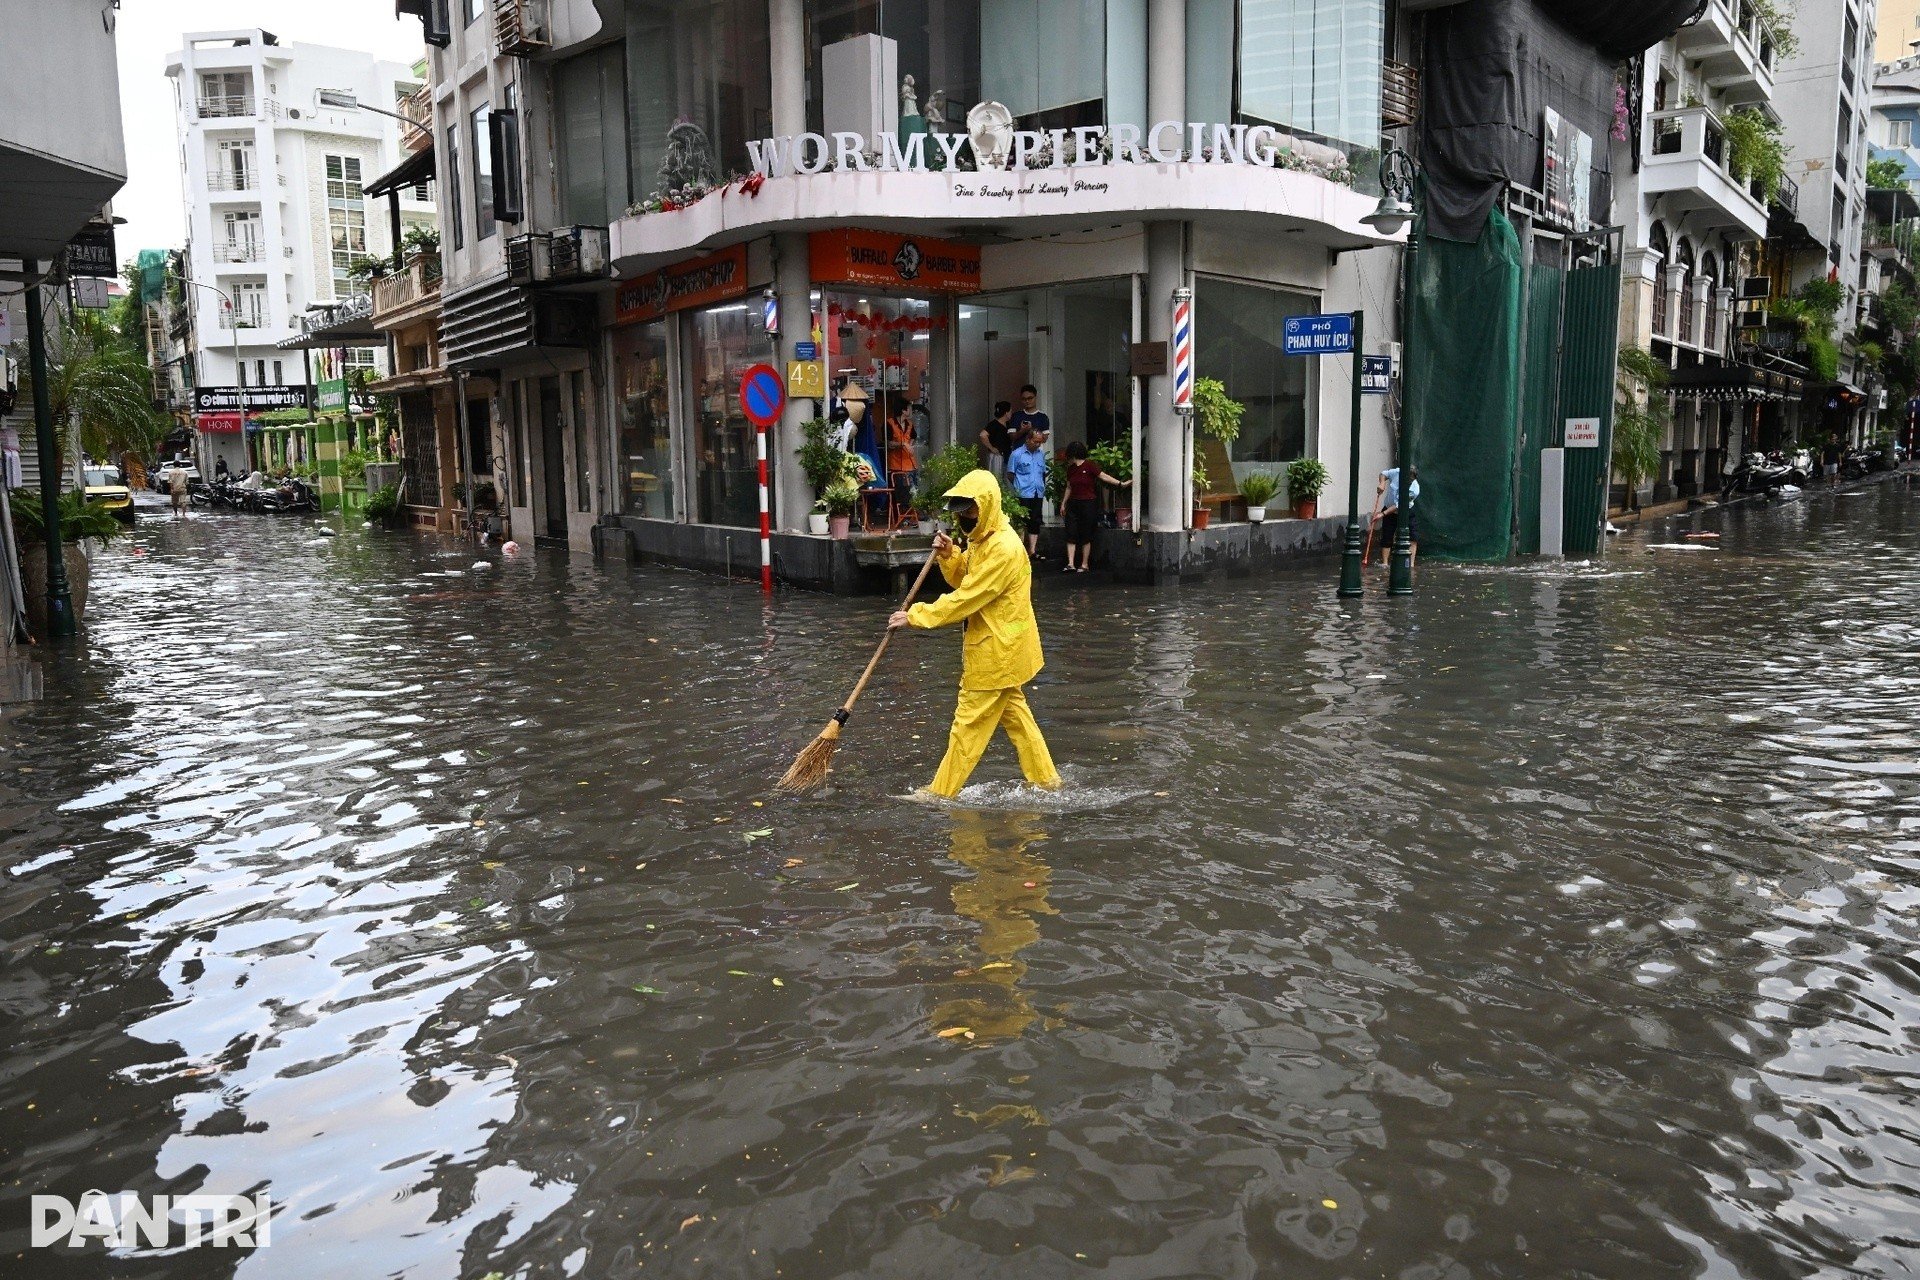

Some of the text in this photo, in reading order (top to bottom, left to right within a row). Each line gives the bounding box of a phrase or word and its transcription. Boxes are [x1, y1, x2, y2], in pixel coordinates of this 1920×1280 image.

[746, 119, 1277, 178] WORMY PIERCING
[954, 184, 975, 197] Fine
[1017, 183, 1034, 195] and
[1038, 182, 1069, 197] Luxury
[1073, 179, 1109, 194] Piercing
[850, 247, 980, 275] BUFFALO BARBER SHOP
[1311, 320, 1331, 331] PHỐ
[1287, 331, 1349, 349] PHAN HUY ÍCH
[790, 363, 819, 386] 43
